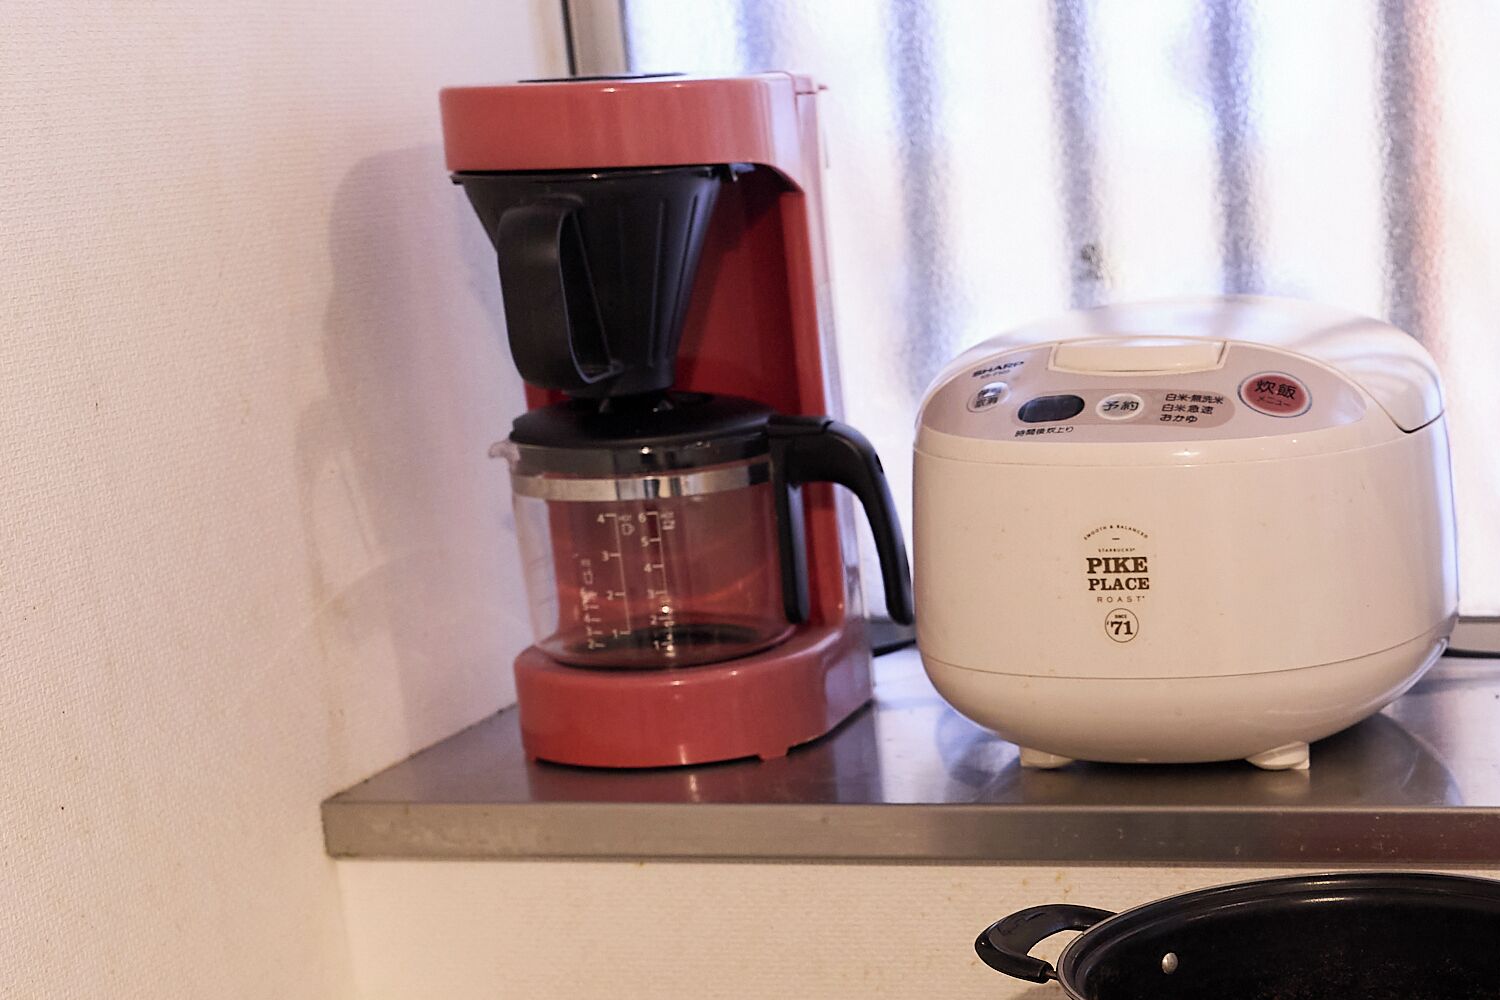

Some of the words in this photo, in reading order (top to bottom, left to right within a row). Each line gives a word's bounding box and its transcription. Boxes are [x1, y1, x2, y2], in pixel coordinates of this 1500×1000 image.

[1255, 380, 1297, 399] 炊飯
[1102, 401, 1139, 411] 予約
[1162, 404, 1213, 414] 白米急速
[1160, 414, 1198, 423] おかゆ
[1086, 556, 1149, 574] PIKE
[1087, 577, 1150, 591] PLACE
